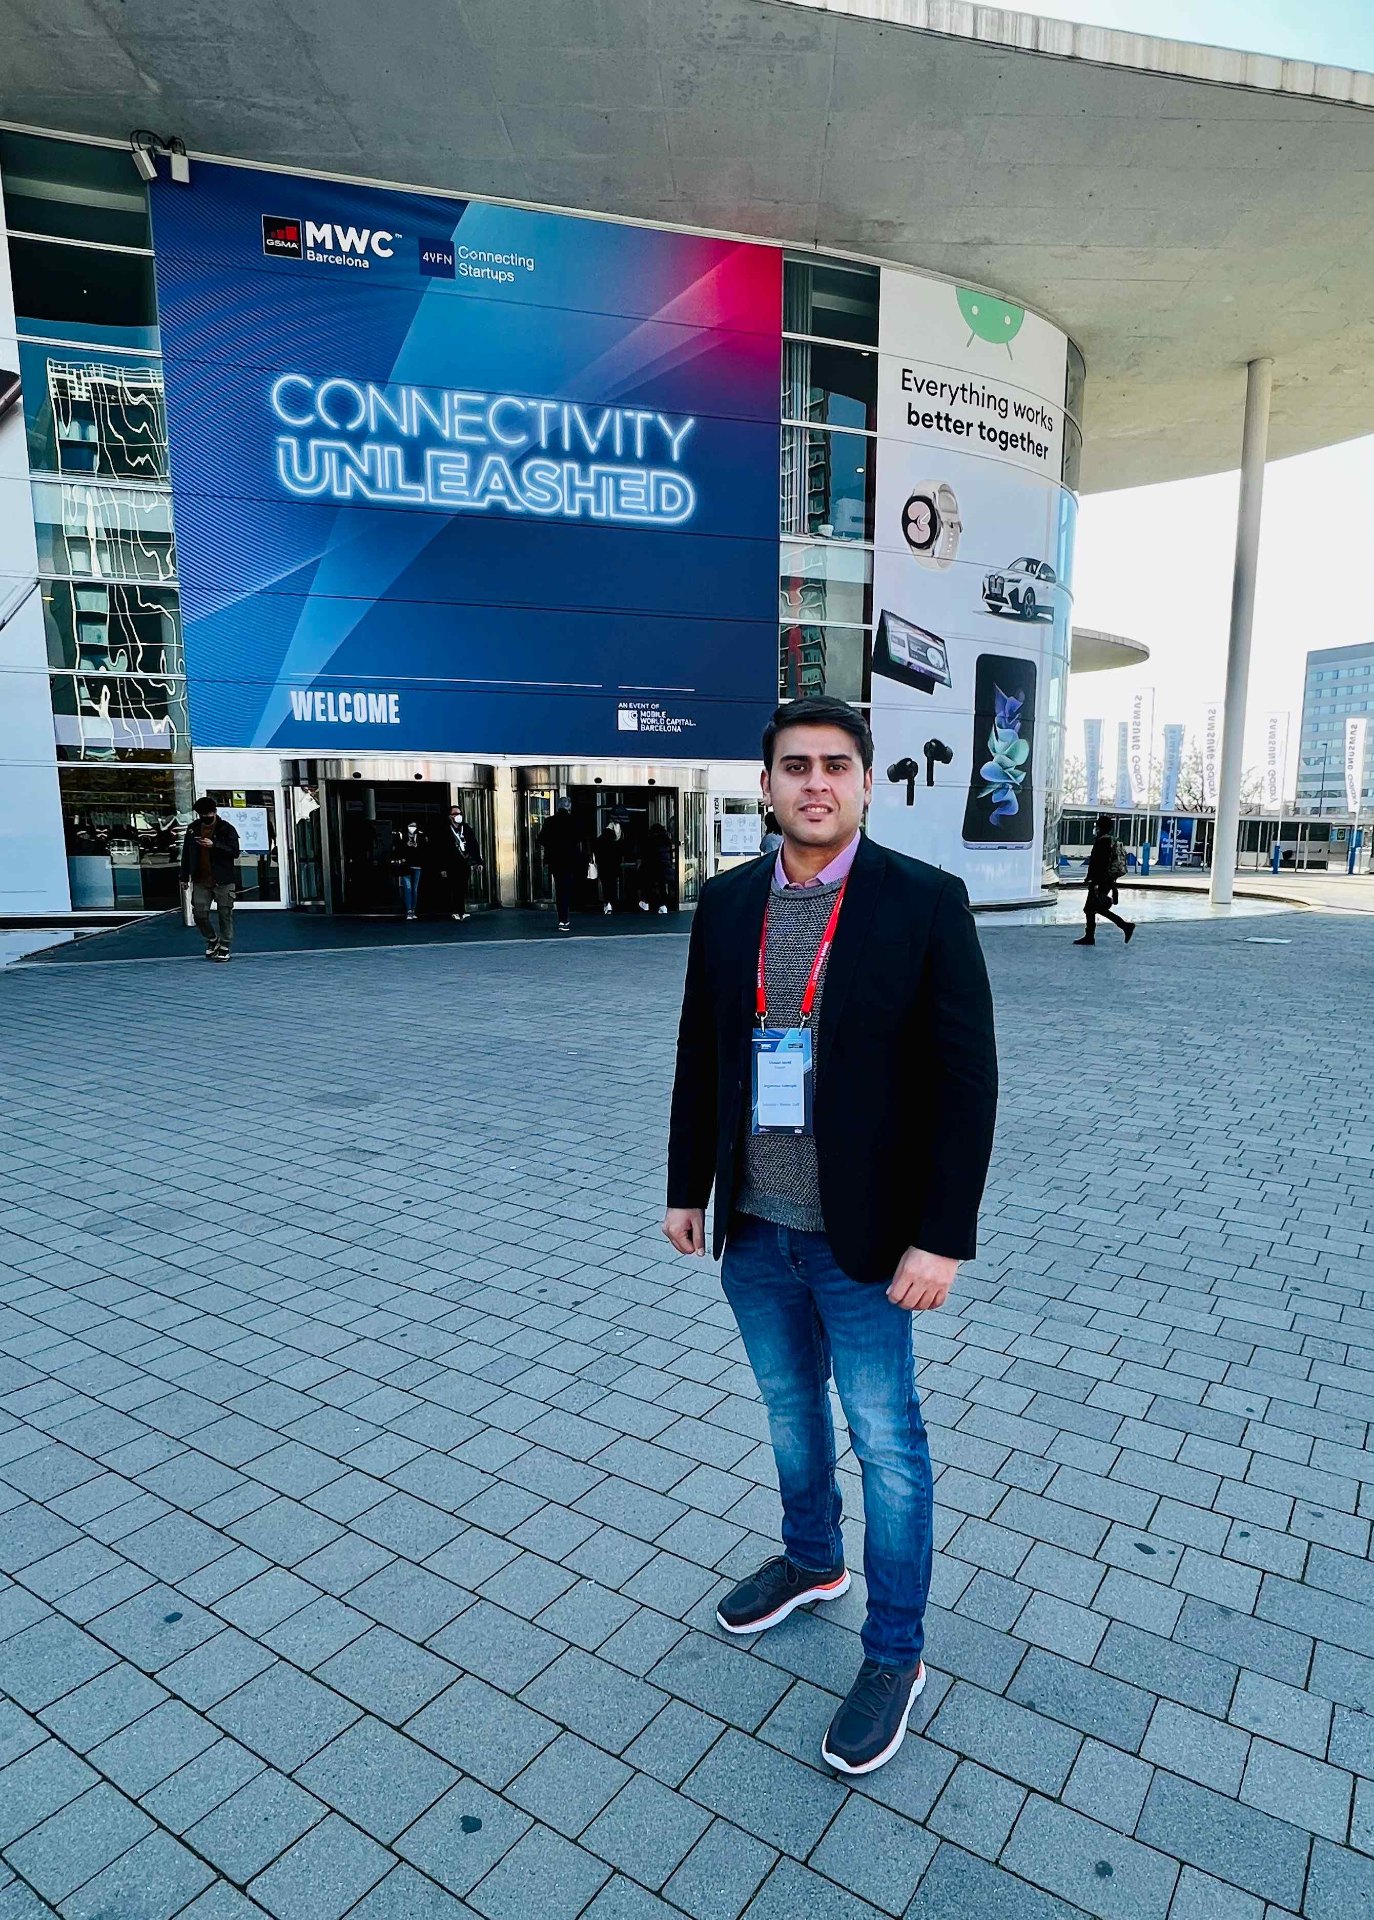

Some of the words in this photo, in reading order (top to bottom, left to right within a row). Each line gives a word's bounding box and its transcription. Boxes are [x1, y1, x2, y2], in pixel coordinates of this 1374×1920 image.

[266, 239, 299, 250] GSMA
[306, 249, 370, 269] Barcelona
[422, 252, 453, 266] 4YFN
[458, 246, 536, 271] Connecting
[458, 262, 516, 283] Startups
[901, 368, 1009, 419] Everything
[1013, 401, 1054, 433] works
[270, 373, 697, 462] CONNECTIVITY
[907, 402, 974, 437] better
[978, 421, 1049, 460] together
[275, 436, 698, 526] UNLEASHED
[290, 690, 401, 724] WELCOME
[640, 710, 667, 719] MOBILE
[640, 718, 665, 726] WORLD
[640, 725, 682, 733] BARCELONA
